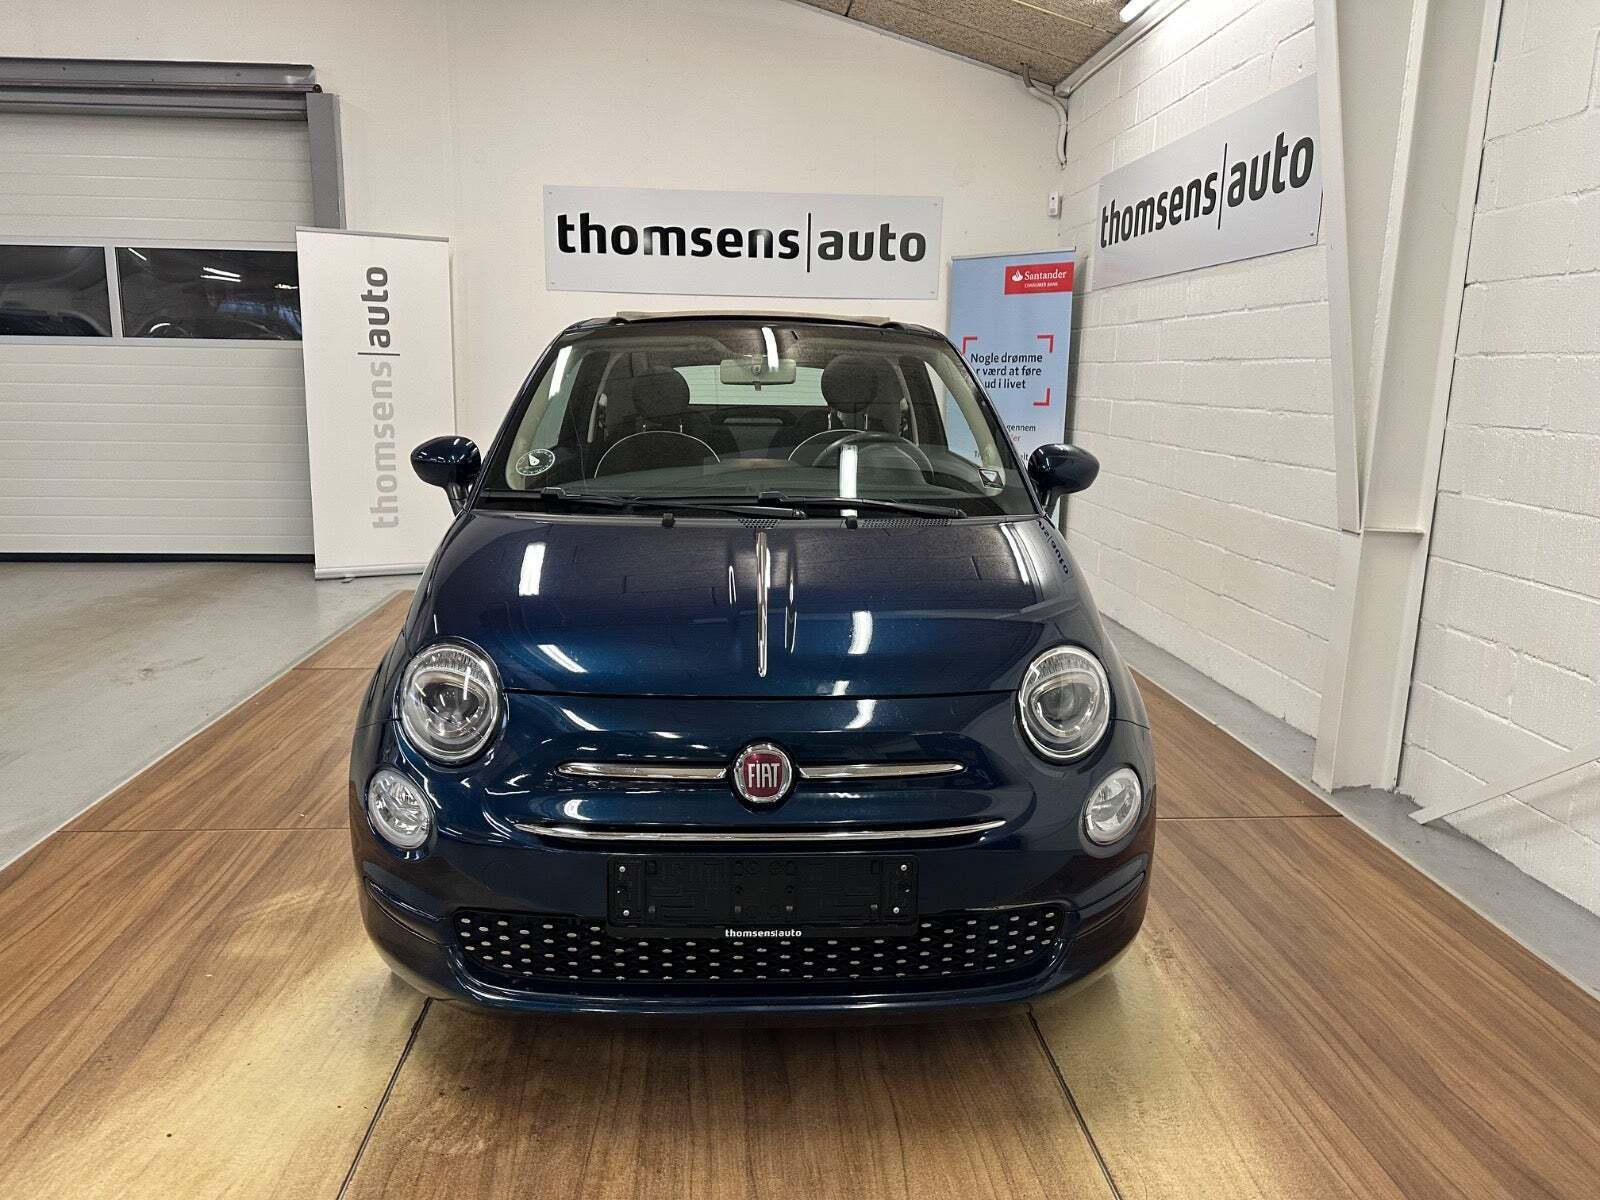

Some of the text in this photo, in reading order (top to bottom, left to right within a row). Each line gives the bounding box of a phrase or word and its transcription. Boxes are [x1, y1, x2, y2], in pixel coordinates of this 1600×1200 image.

[1024, 268, 1067, 281] Santander
[970, 352, 1043, 366] Nogle drømme
[983, 365, 1007, 376] værd
[1009, 366, 1019, 376] at
[1022, 365, 1042, 376] føre
[984, 379, 996, 389] ud
[1004, 379, 1026, 389] livet
[747, 762, 781, 788] FIAT
